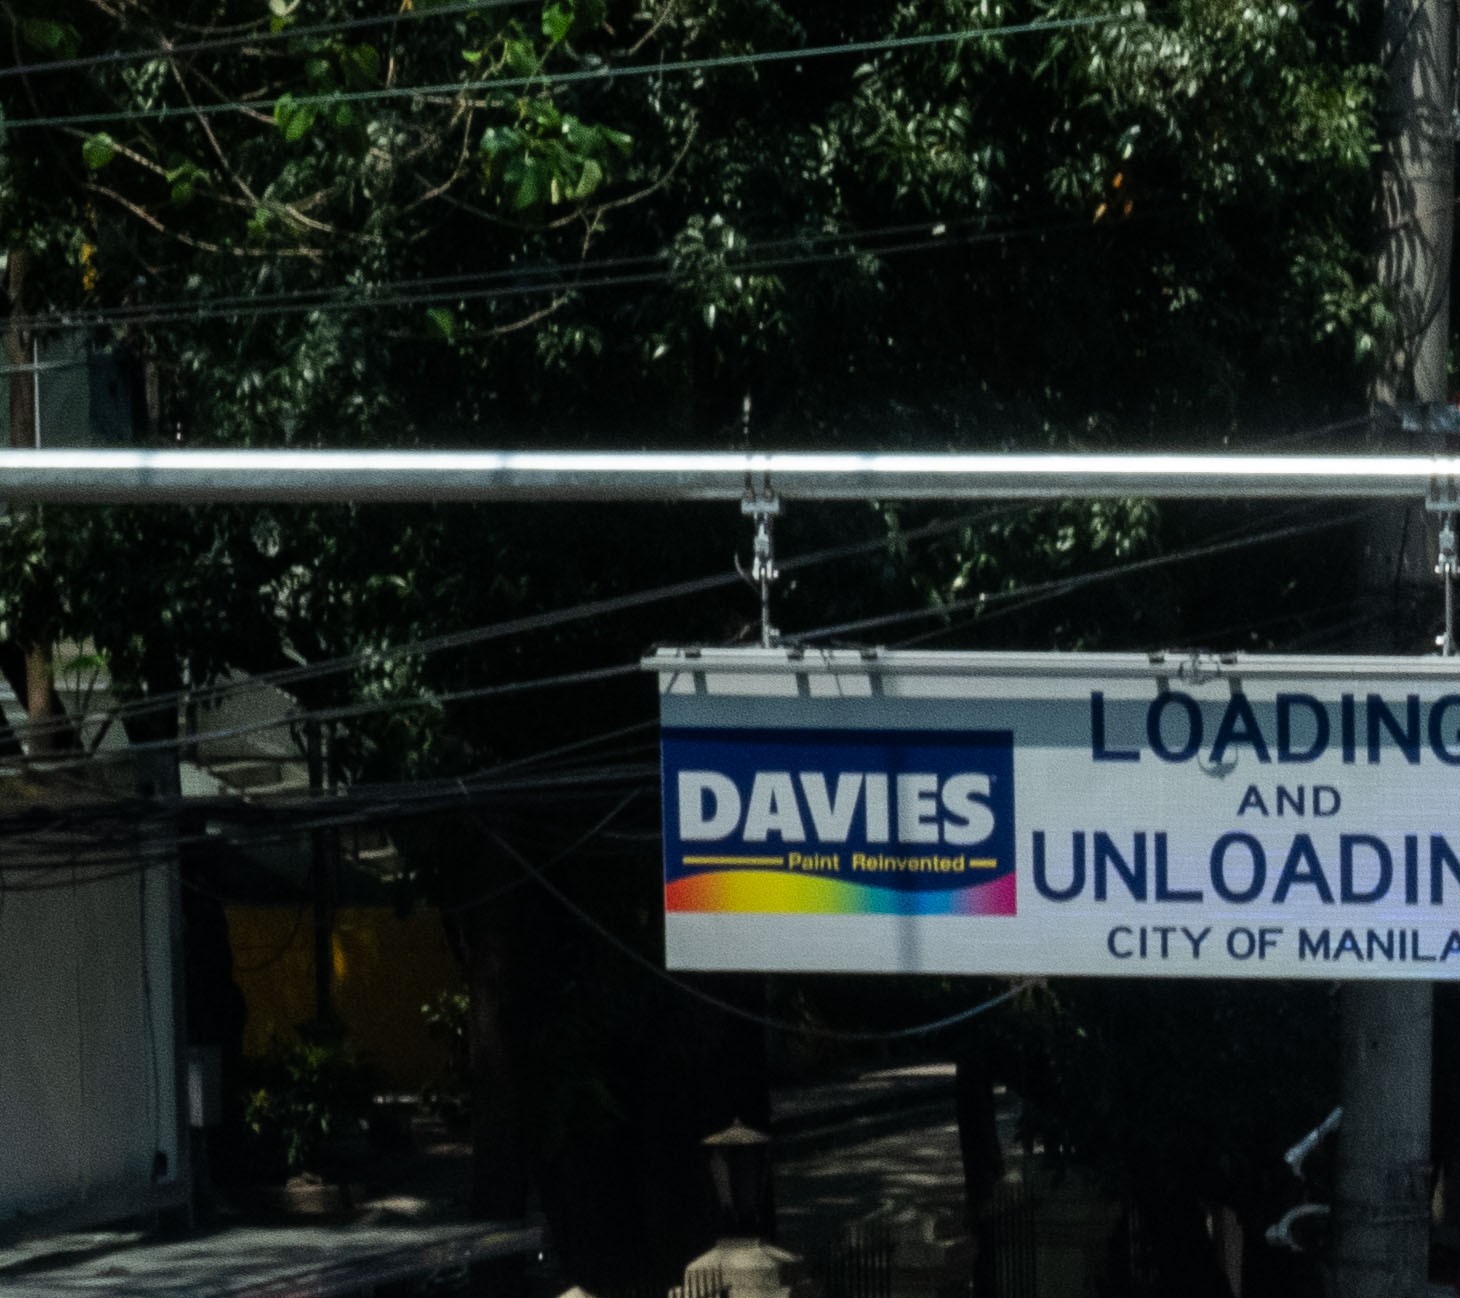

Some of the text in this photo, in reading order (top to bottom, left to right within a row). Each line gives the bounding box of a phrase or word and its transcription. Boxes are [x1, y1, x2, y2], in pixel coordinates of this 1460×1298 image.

[677, 771, 995, 843] DAVIES
[1237, 786, 1341, 818] AND
[788, 852, 965, 874] Paint Reinvented
[1107, 926, 1212, 959] CITY
[1226, 928, 1283, 960] OF
